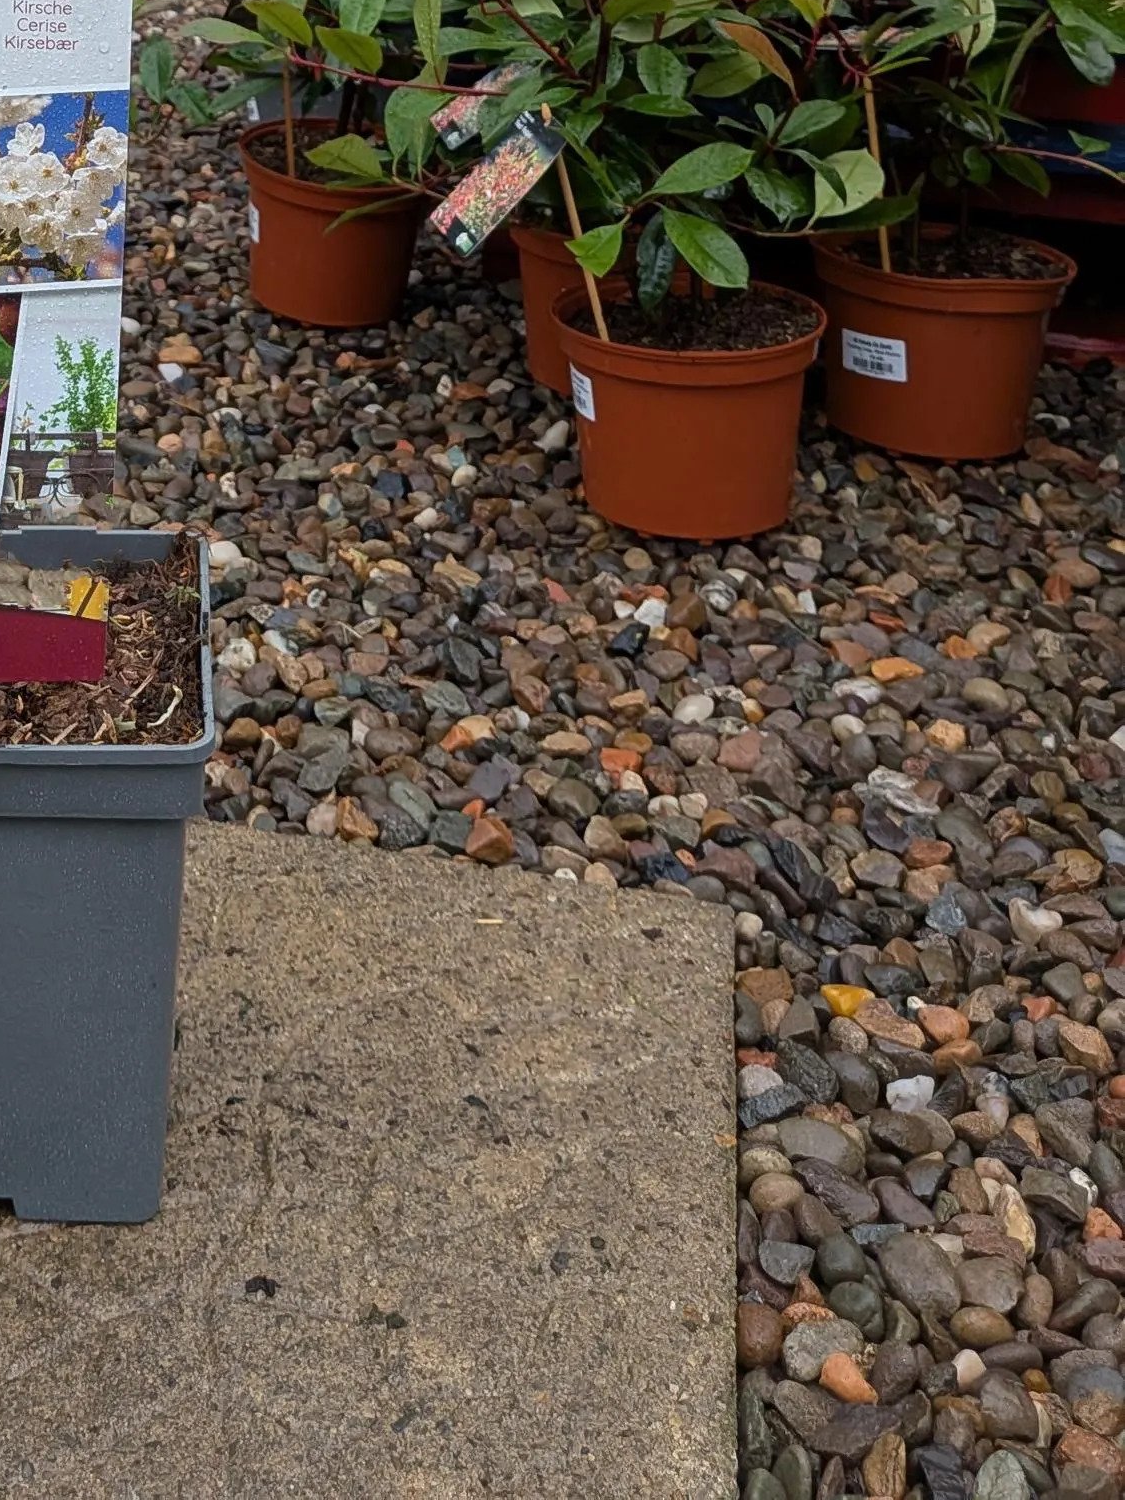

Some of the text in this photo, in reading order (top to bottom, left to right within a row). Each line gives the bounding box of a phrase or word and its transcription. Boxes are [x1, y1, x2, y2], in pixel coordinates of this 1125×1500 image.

[13, 0, 72, 15] Kirsche
[17, 18, 67, 33] Cerise
[5, 35, 79, 50] Kirsebær
